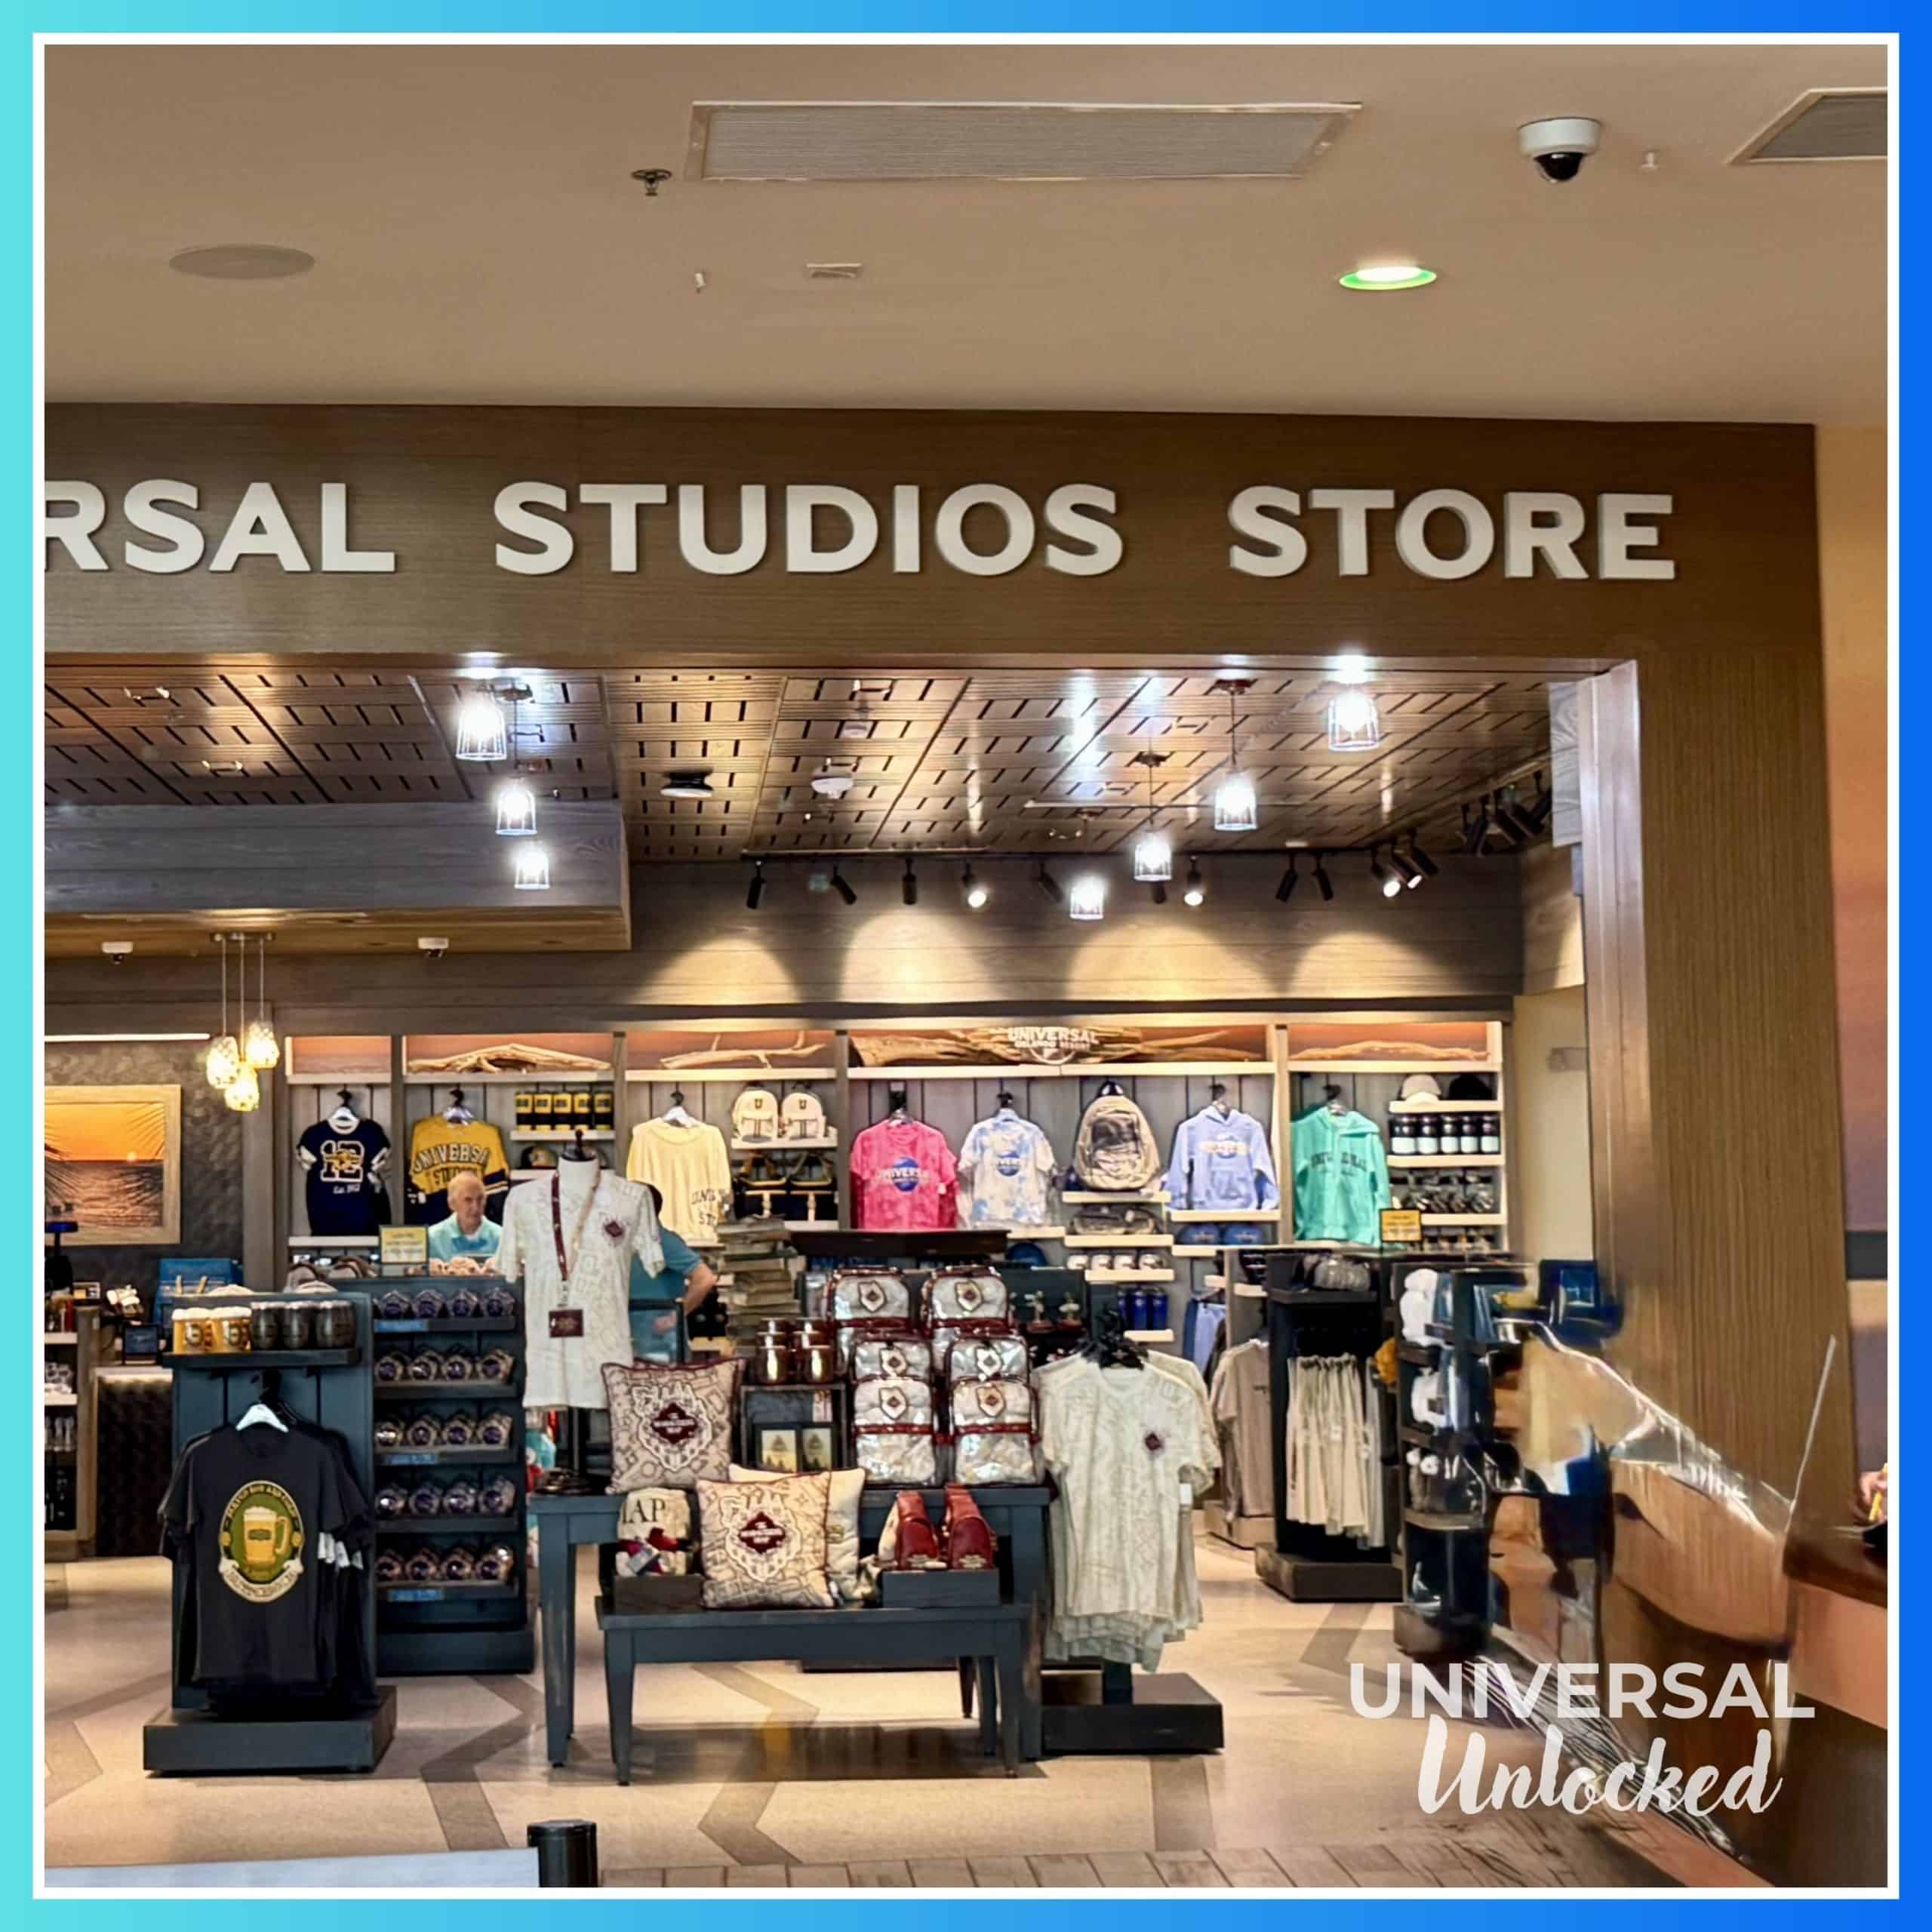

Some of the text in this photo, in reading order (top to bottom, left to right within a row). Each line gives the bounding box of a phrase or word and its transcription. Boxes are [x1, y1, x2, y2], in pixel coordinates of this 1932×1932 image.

[494, 481, 1124, 576] STUDIOS
[1227, 485, 1675, 580] STORE
[1008, 1026, 1100, 1044] UNIVERSAL
